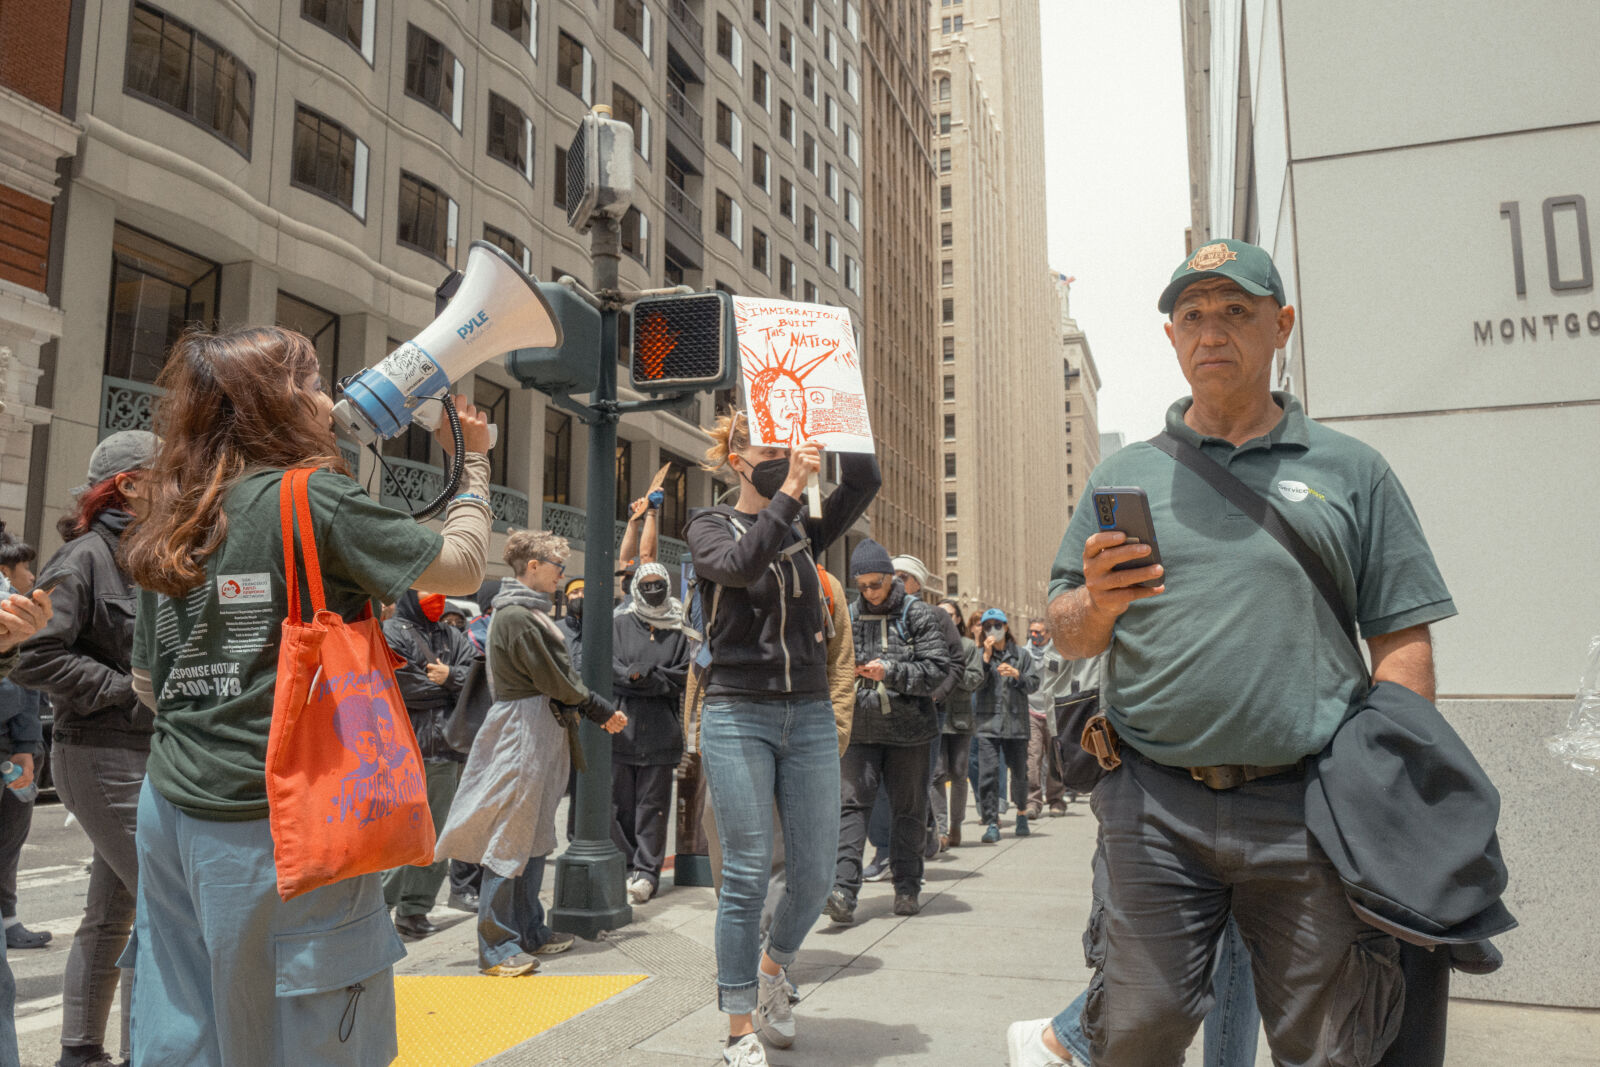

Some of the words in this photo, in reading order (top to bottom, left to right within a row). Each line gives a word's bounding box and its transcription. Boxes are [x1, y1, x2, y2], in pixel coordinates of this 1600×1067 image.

[1500, 194, 1593, 297] 10
[748, 307, 839, 321] IMMIGRATION
[457, 310, 489, 340] PYLE
[777, 318, 817, 328] BUILT
[1473, 310, 1600, 344] MONTGO
[758, 327, 786, 340] THIS
[790, 332, 840, 348] NATION
